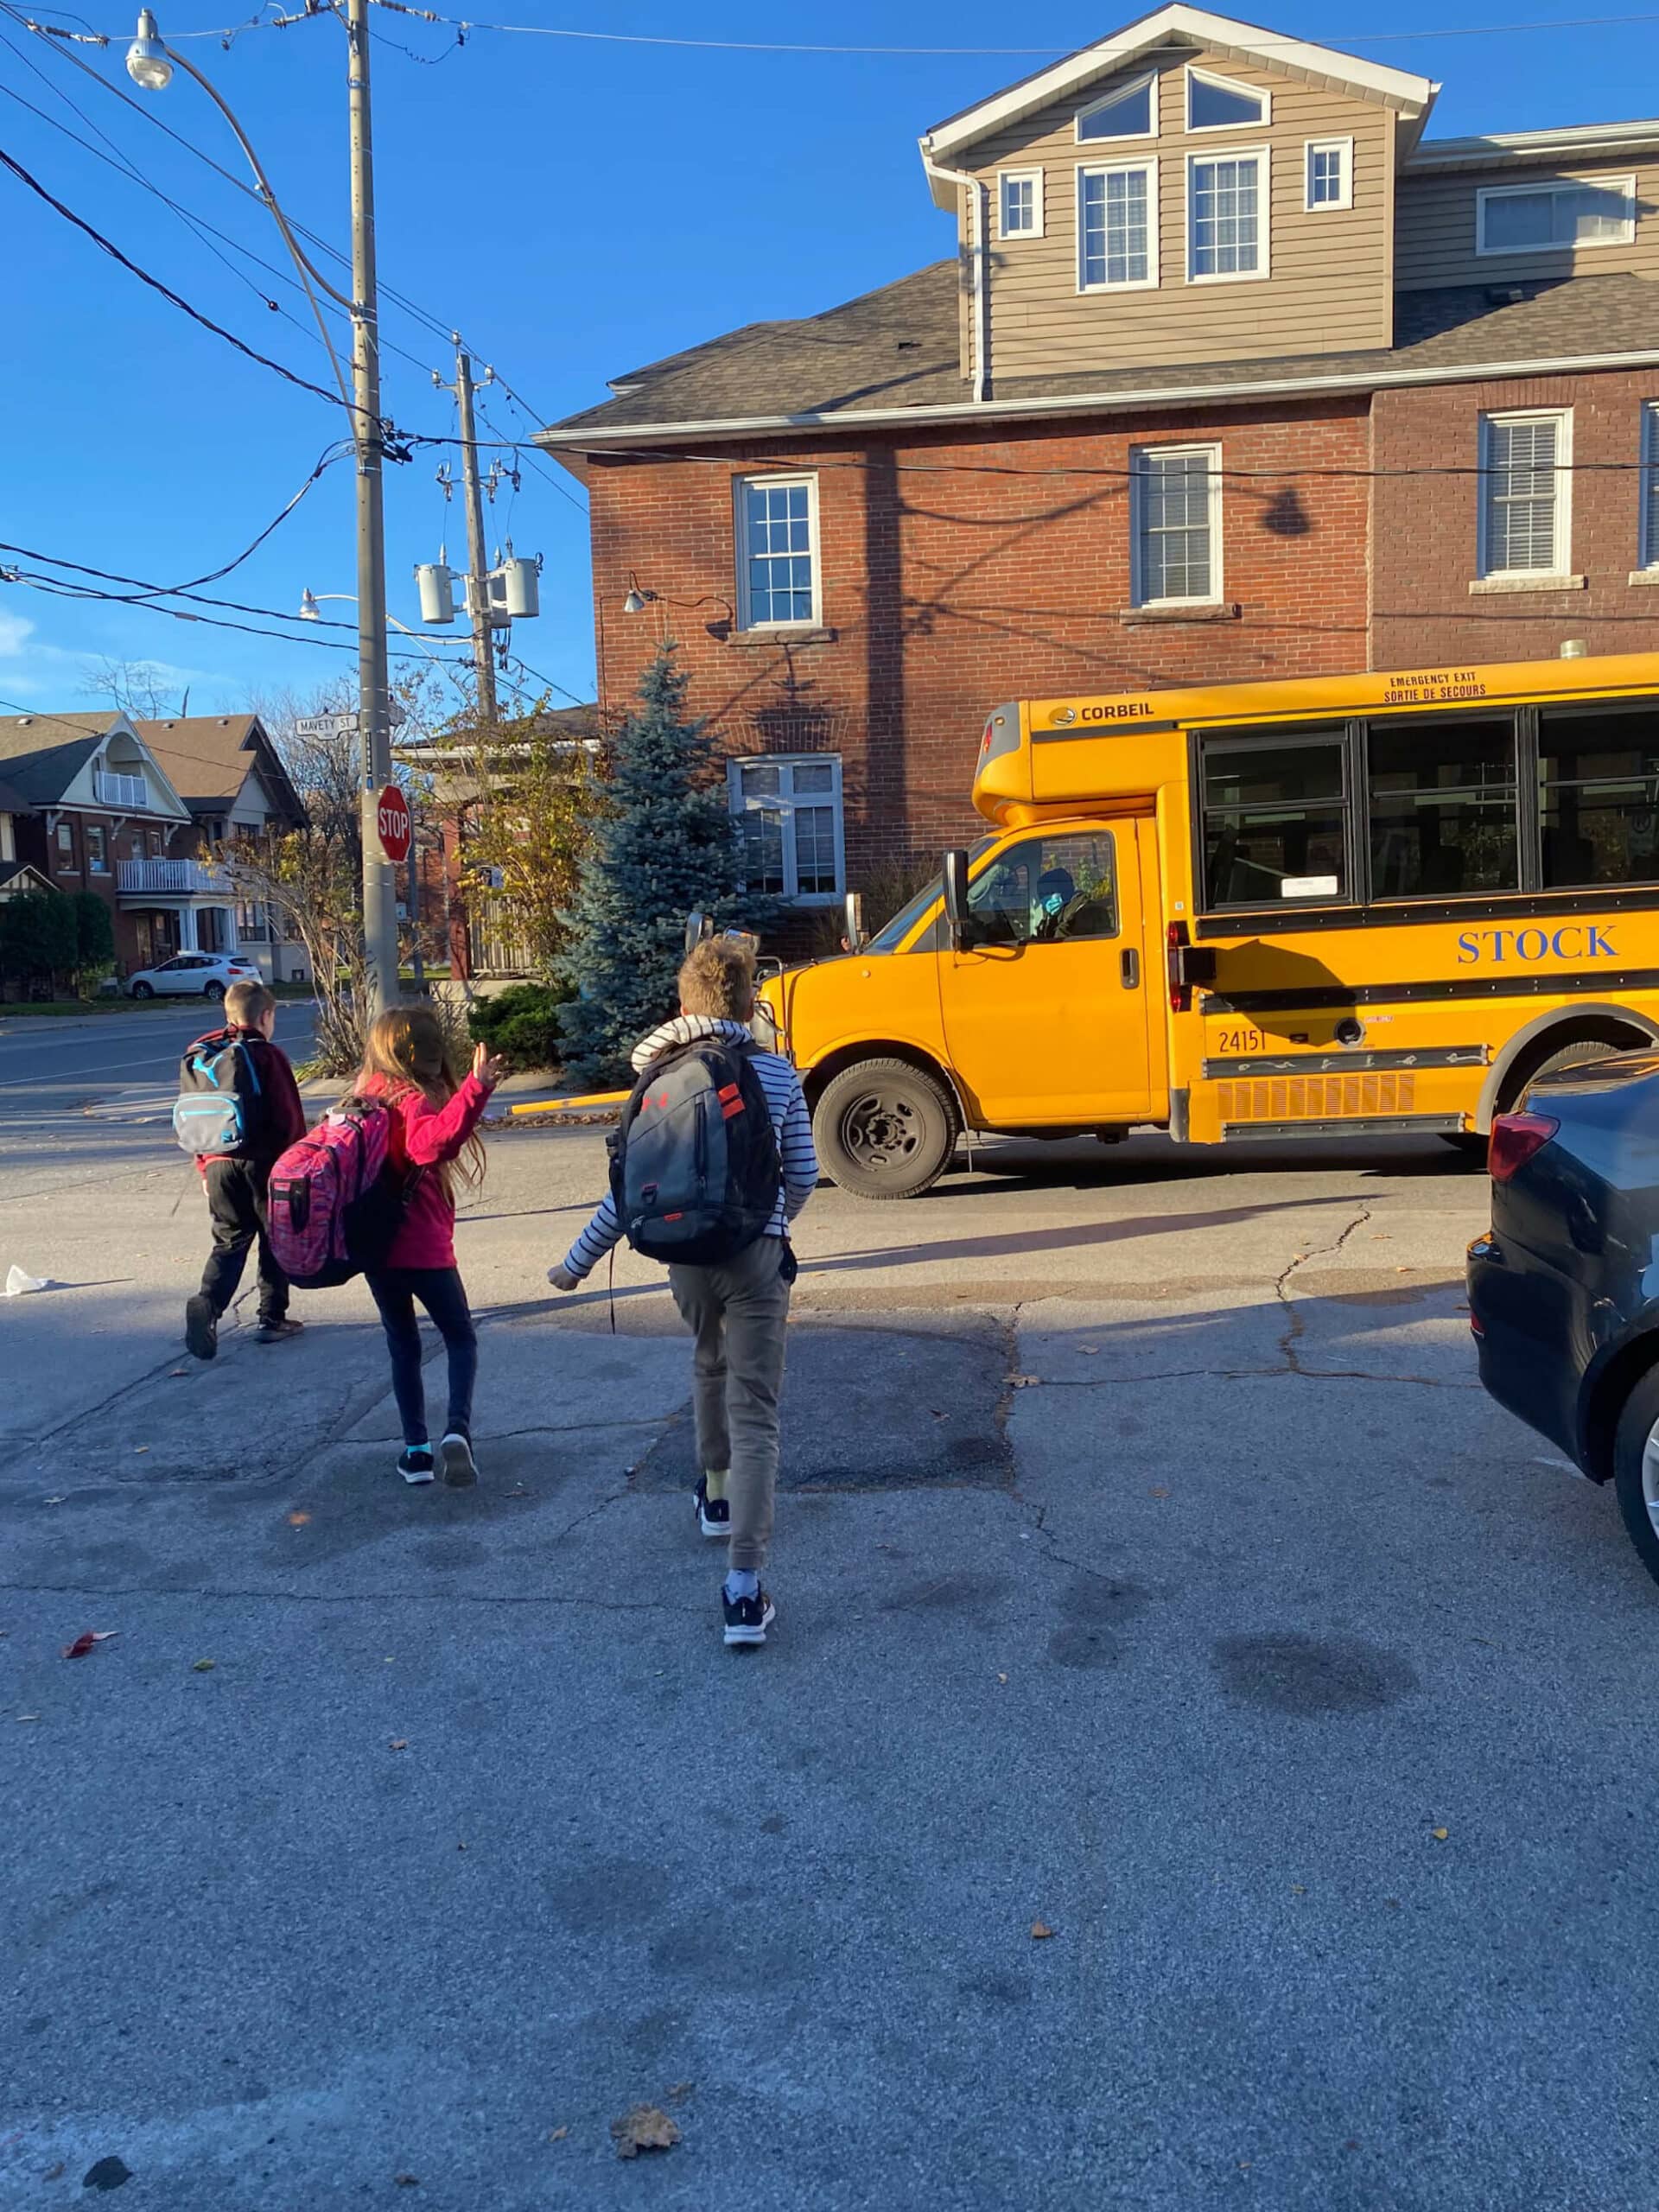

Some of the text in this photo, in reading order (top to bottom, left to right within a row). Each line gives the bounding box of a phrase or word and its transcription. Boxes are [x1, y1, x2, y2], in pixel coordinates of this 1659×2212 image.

[1390, 671, 1476, 687] EMERGENCY EXIT
[1384, 683, 1486, 702] SORTIE DE SECOURS
[1081, 702, 1154, 721] CORBEIL
[301, 717, 350, 733] MAVETY ST
[379, 807, 409, 840] STOP
[1458, 925, 1620, 964] STOCK
[1218, 1029, 1266, 1052] 24151
